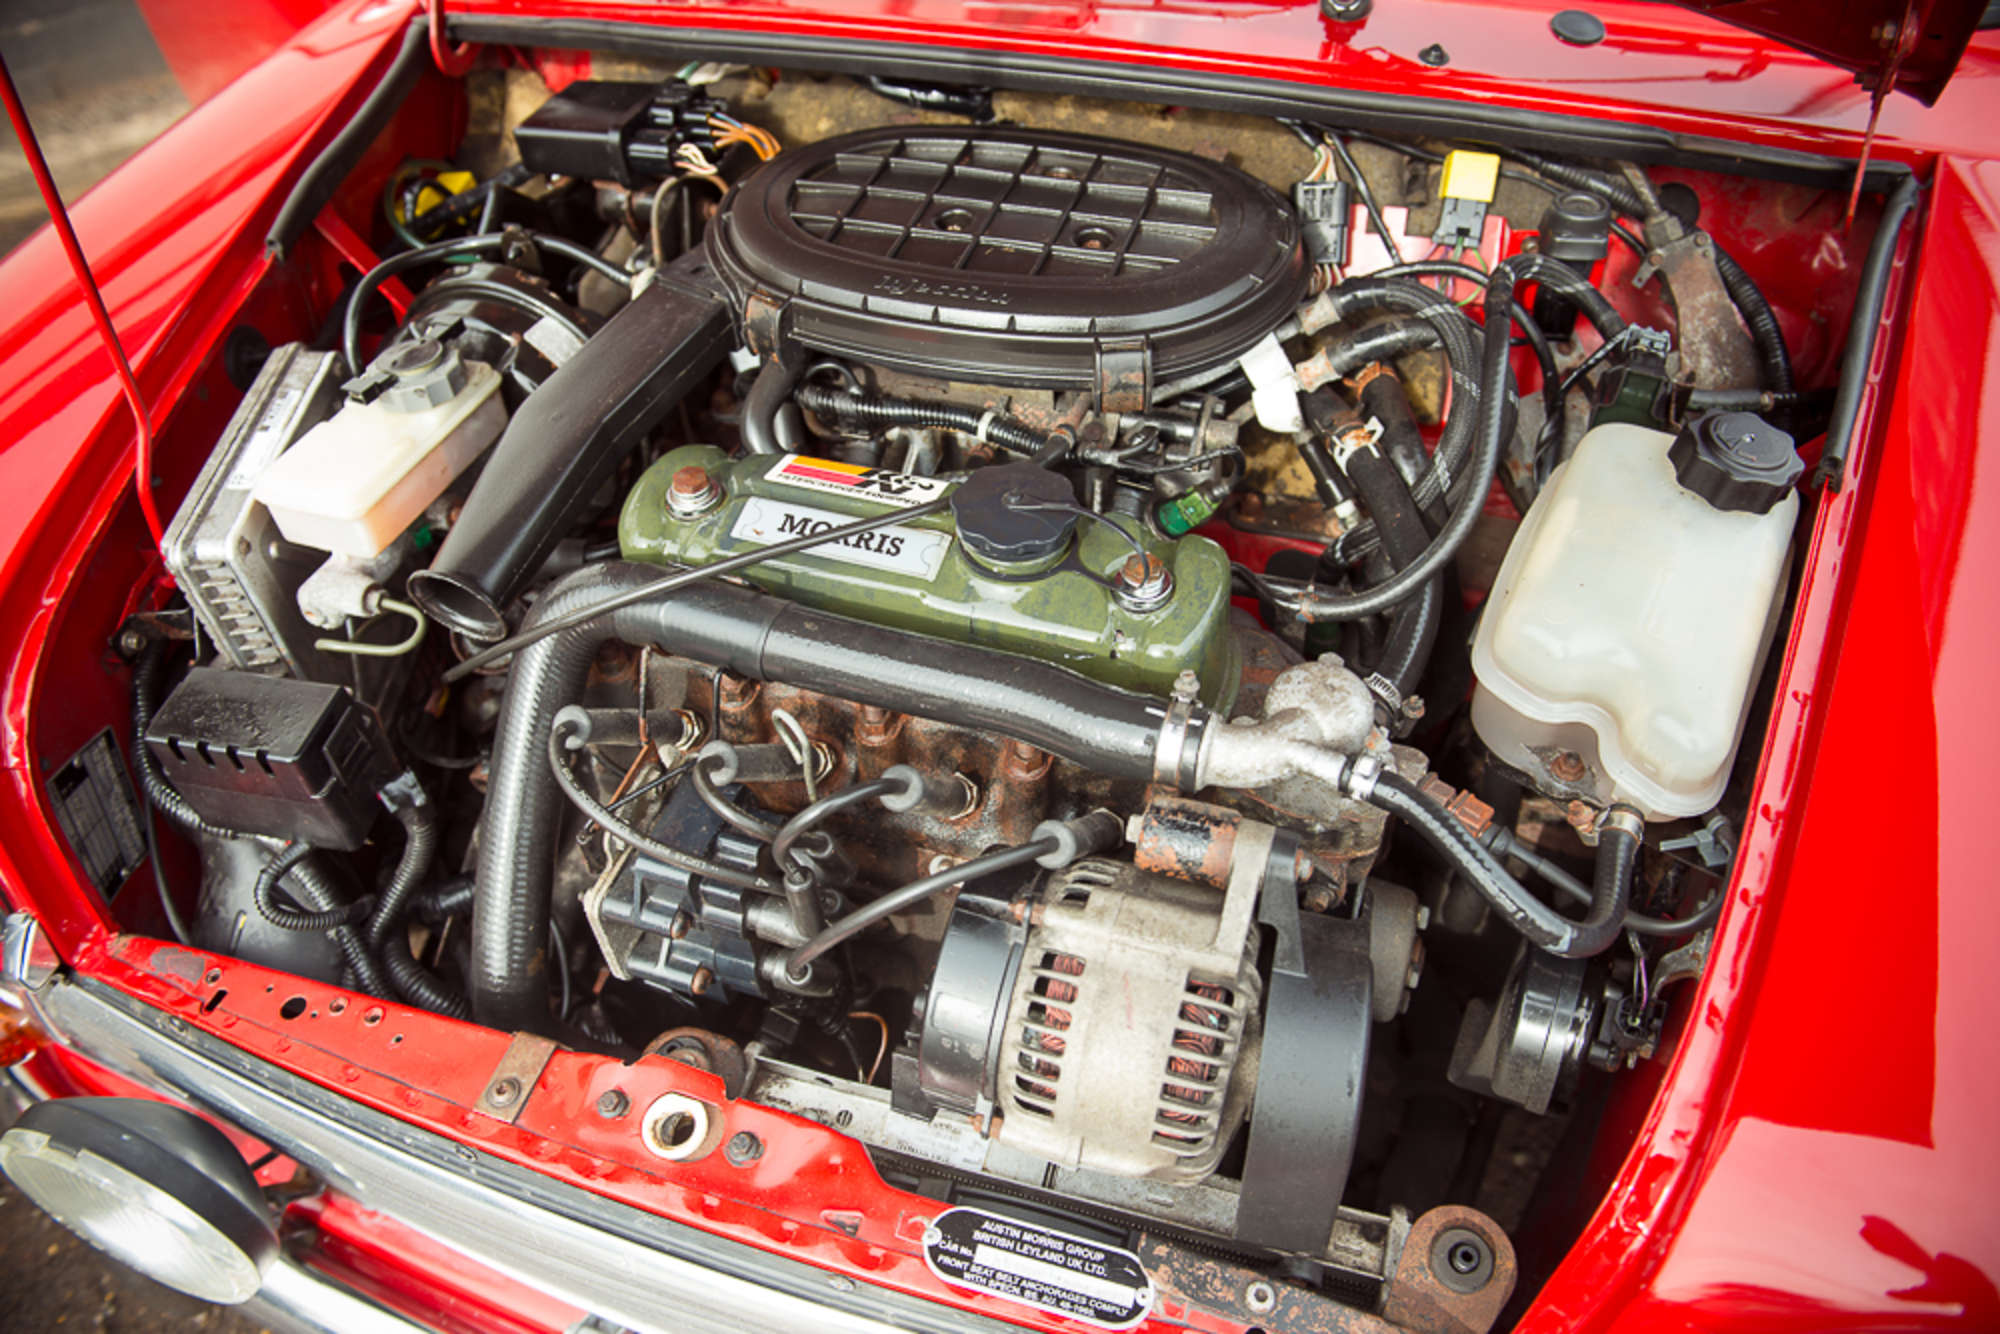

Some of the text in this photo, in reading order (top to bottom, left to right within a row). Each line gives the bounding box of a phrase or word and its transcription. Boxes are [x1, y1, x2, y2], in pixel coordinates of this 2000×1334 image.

[938, 1240, 960, 1253] CAR
[972, 1230, 1107, 1277] BRITISH LEYLAND UK LTD.
[981, 1220, 1105, 1262] AUSTIN MORRIS GROUP
[937, 1254, 969, 1272] FRONT
[995, 1272, 1020, 1286] BELT
[1020, 1280, 1087, 1305] ANCHORAGES
[1087, 1299, 1129, 1317] COMPLY
[963, 1272, 988, 1286] WITH
